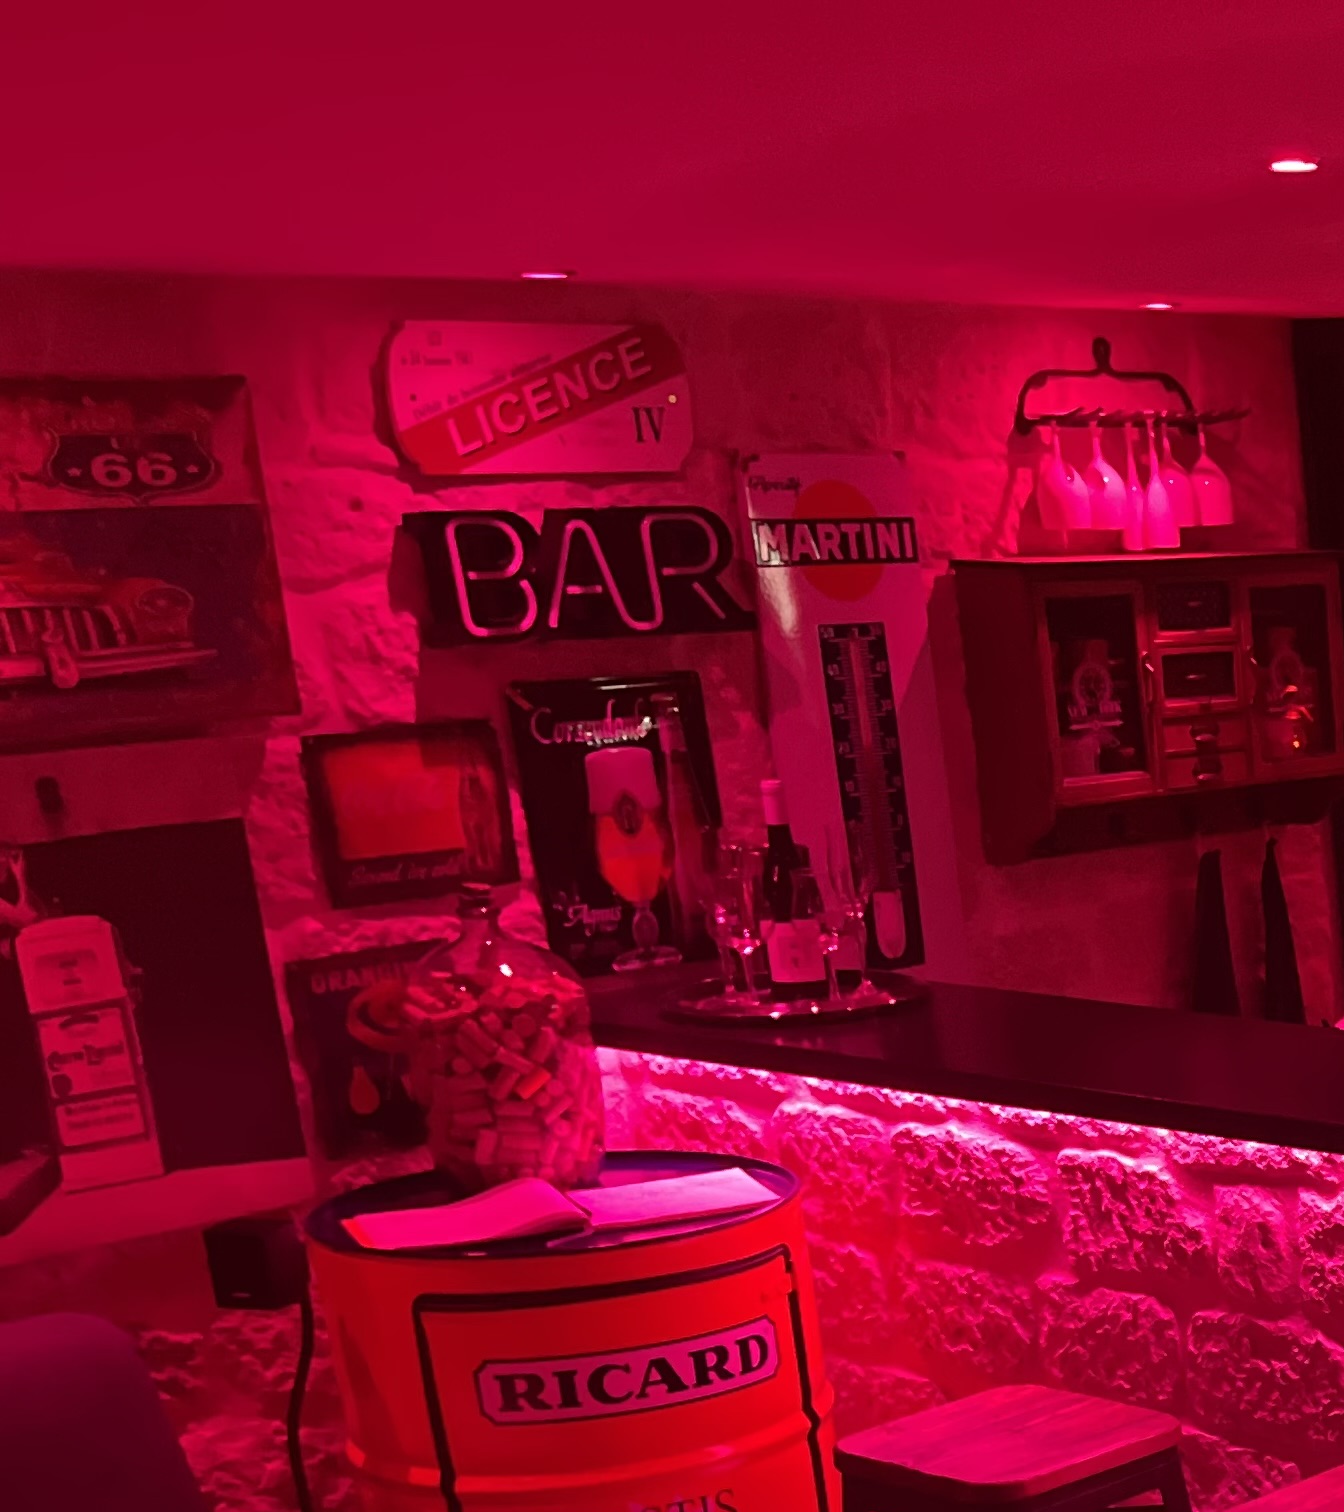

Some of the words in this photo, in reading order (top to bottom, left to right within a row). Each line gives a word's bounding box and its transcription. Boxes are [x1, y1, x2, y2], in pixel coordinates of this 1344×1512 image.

[446, 336, 652, 457] LICENCE
[631, 406, 667, 443] IV
[90, 451, 178, 488] 66
[759, 521, 914, 563] MARTINI
[445, 513, 728, 640] BAR
[494, 1333, 769, 1412] RICARD
